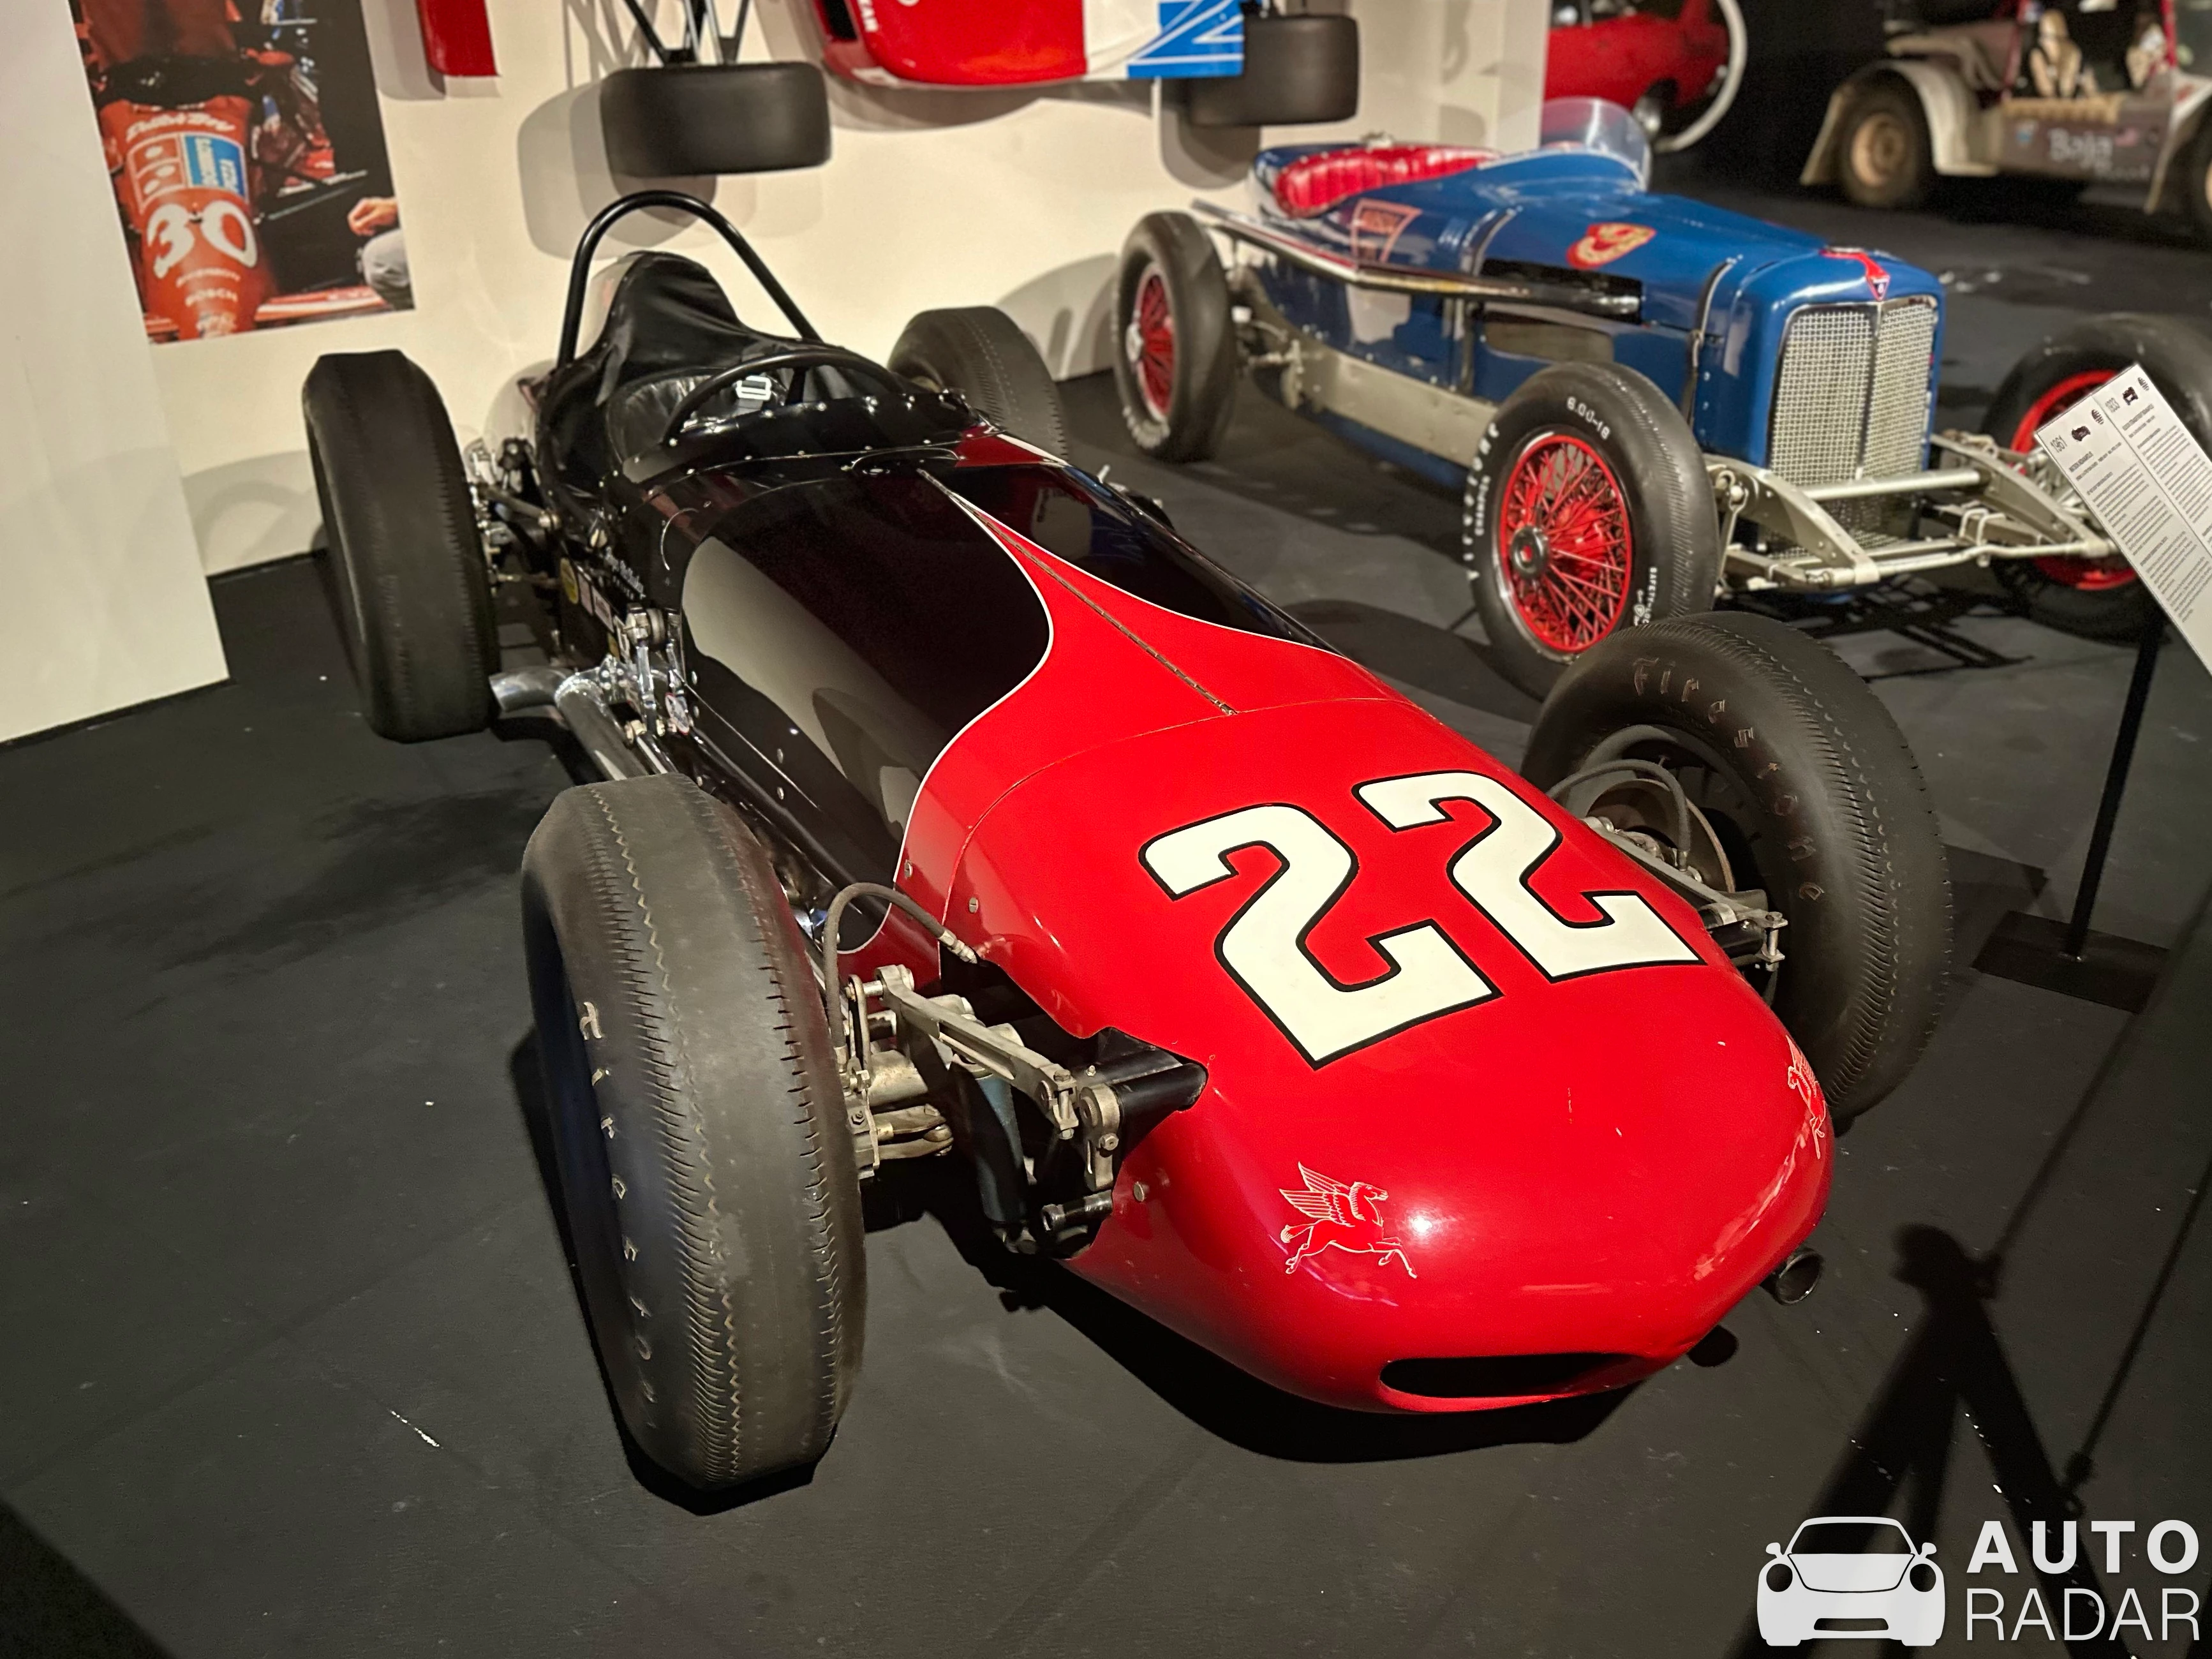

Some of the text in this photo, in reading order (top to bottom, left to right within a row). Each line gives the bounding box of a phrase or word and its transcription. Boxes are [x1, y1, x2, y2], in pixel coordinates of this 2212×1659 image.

[2048, 128, 2114, 170] Baja
[147, 200, 257, 279] 30
[1567, 396, 1610, 440] 6.00-18
[2050, 435, 2068, 453] 1961
[1632, 656, 1825, 902] Firestone
[1138, 770, 1707, 1070] 22
